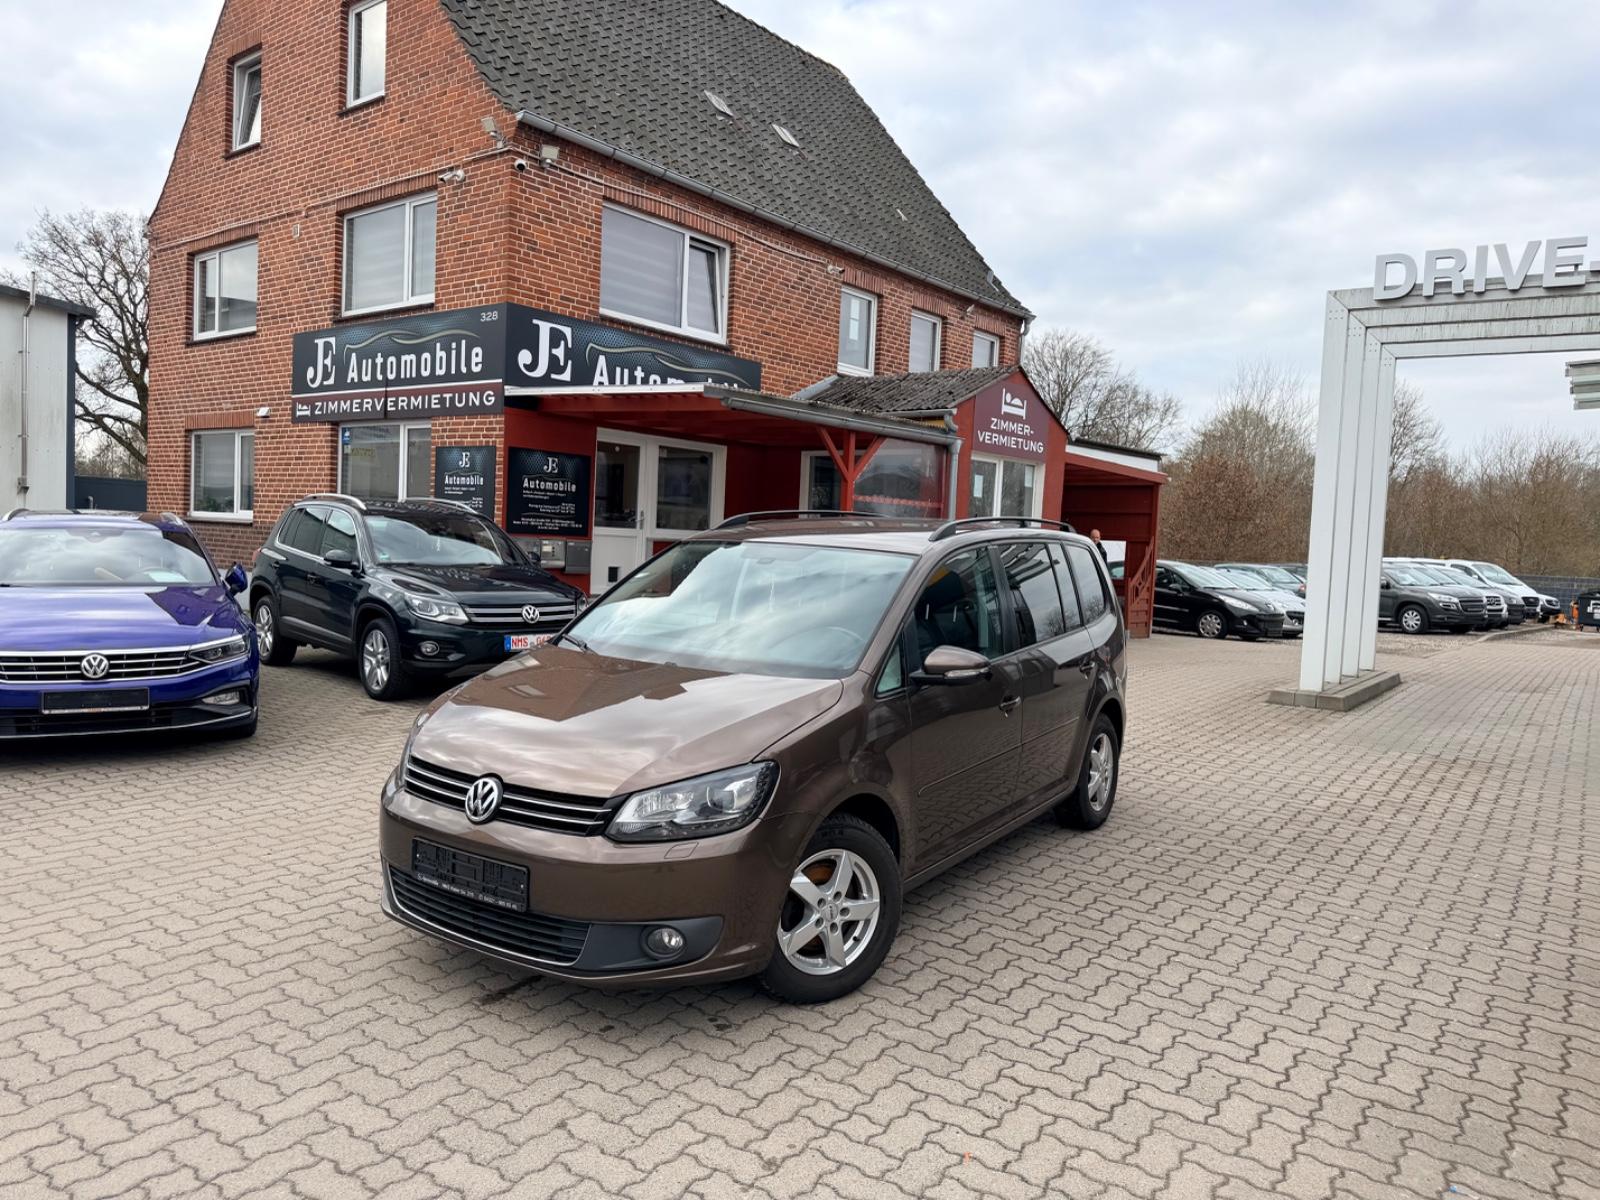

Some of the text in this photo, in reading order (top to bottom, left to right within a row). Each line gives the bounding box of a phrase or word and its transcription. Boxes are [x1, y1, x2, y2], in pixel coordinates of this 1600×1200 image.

[480, 311, 498, 322] 328
[517, 318, 573, 382] JE
[306, 336, 484, 389] JE Automobile
[314, 390, 496, 416] ZIMMERVERMIETUNG
[990, 417, 1034, 436] ZIMMER-
[977, 430, 1044, 454] VERMIETUNG
[543, 456, 559, 474] JE
[444, 474, 484, 486] Automobile
[522, 477, 577, 493] Automobile
